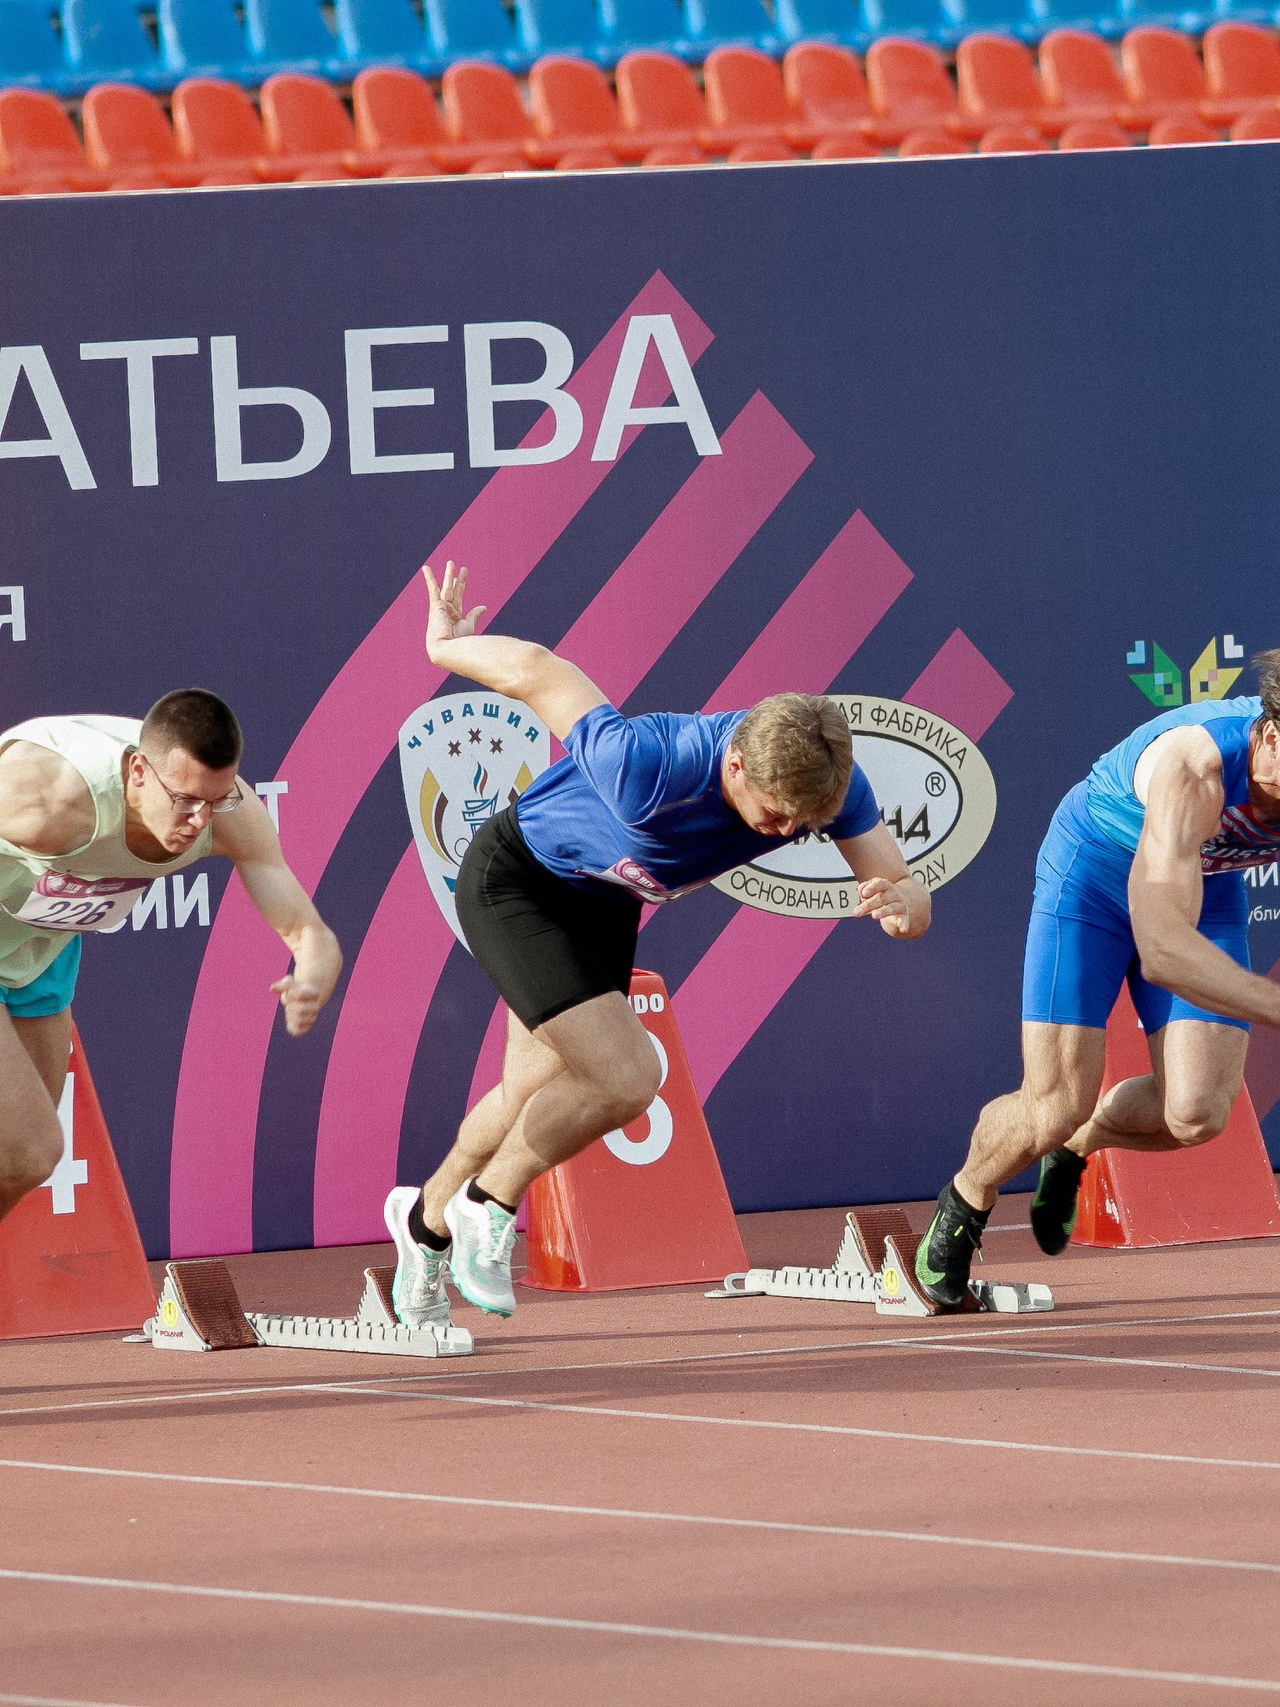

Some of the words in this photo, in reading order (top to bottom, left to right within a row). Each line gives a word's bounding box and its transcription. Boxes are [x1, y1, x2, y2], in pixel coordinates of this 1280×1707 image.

[407, 703, 539, 750] ЧУВАШИЯ
[870, 703, 968, 769] ФАБРИКА
[730, 870, 834, 909] ОСНОВАНА
[839, 891, 850, 909] В
[30, 900, 116, 926] 226
